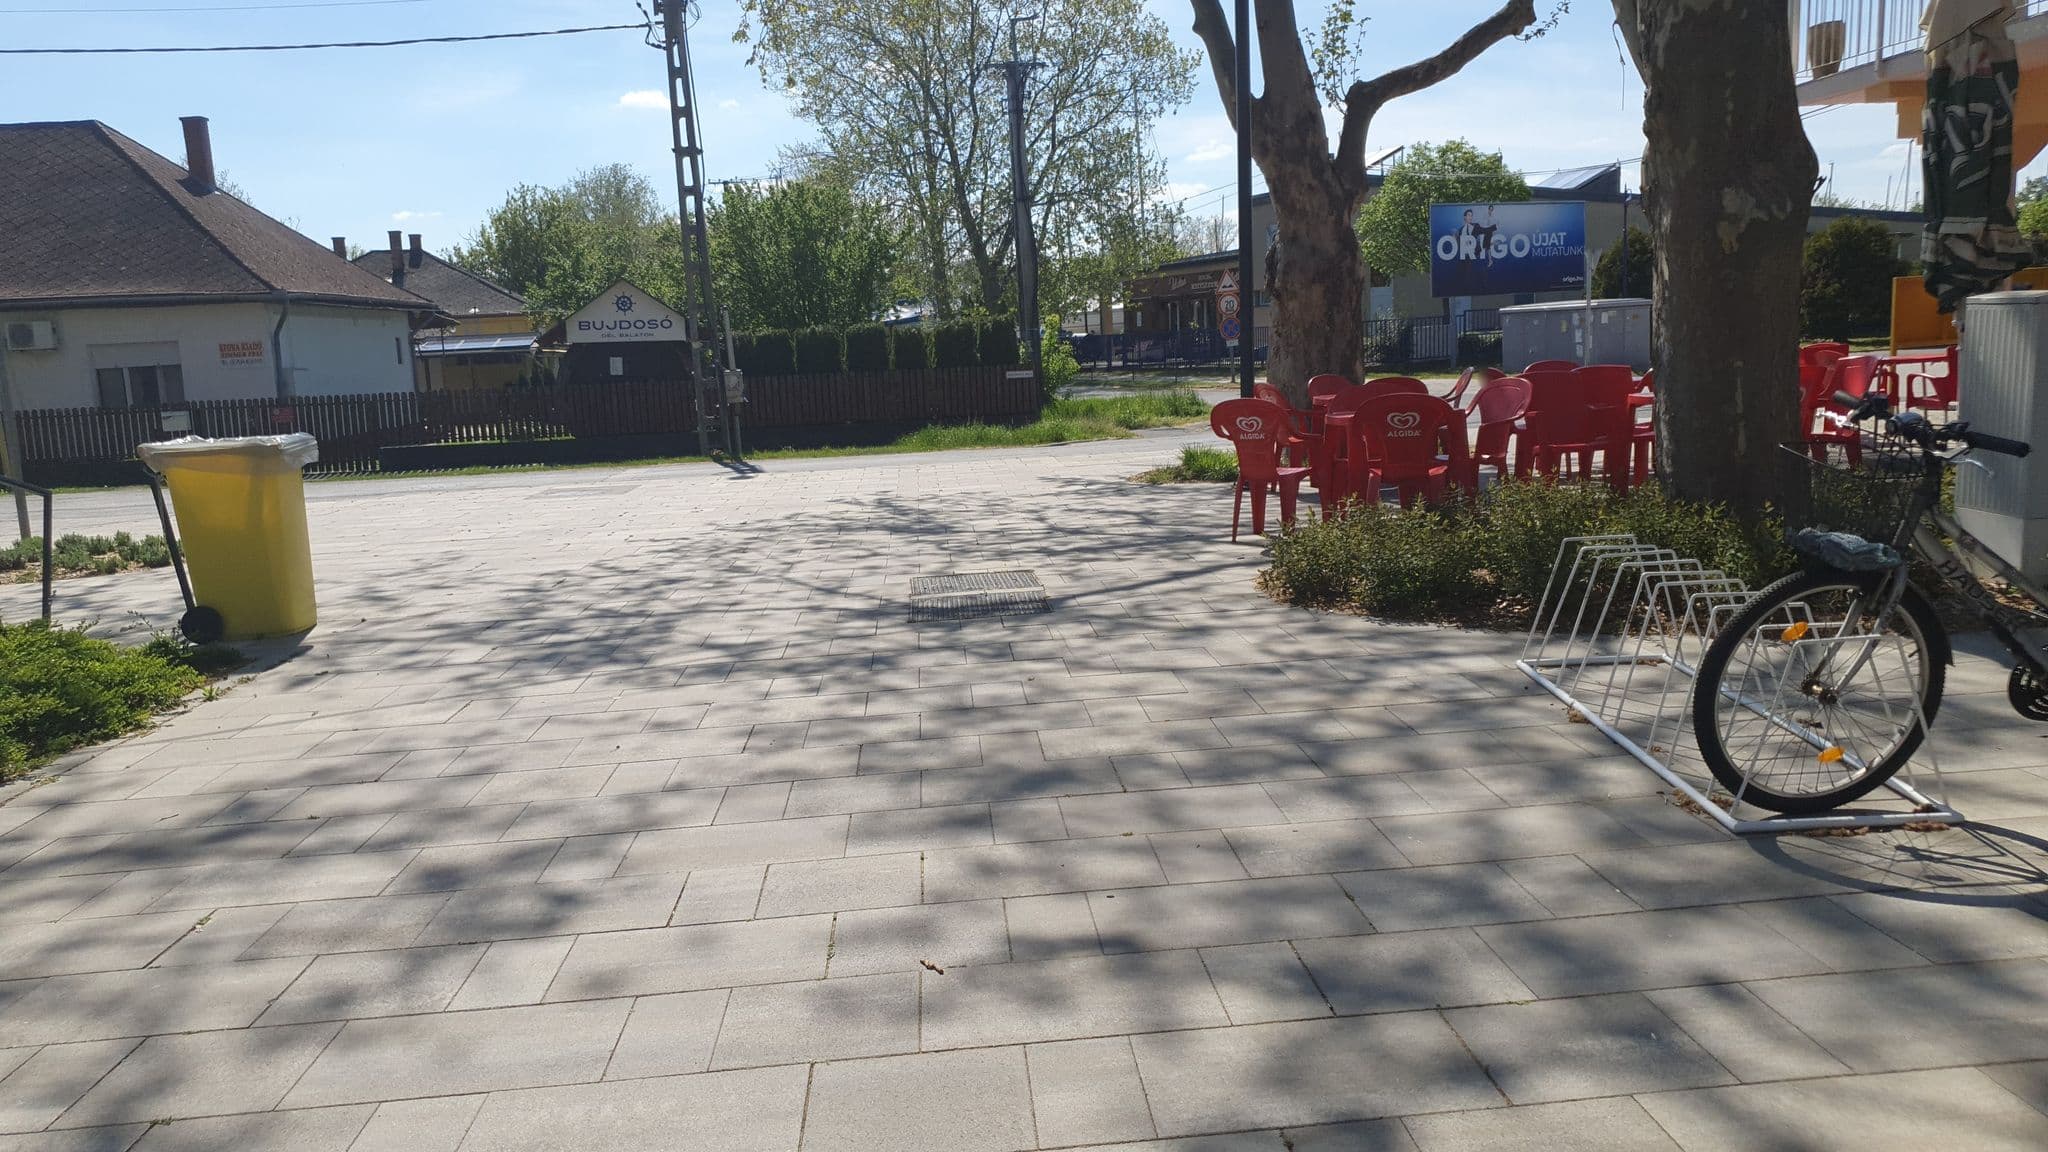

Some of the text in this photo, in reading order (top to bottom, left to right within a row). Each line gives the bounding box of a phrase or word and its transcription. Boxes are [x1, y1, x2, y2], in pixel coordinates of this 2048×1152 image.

[1437, 229, 1567, 261] ORIGO ÚJAT
[1532, 245, 1584, 257] MUTATUNK
[1225, 300, 1235, 311] 20
[578, 315, 673, 331] BUJDOSÓ
